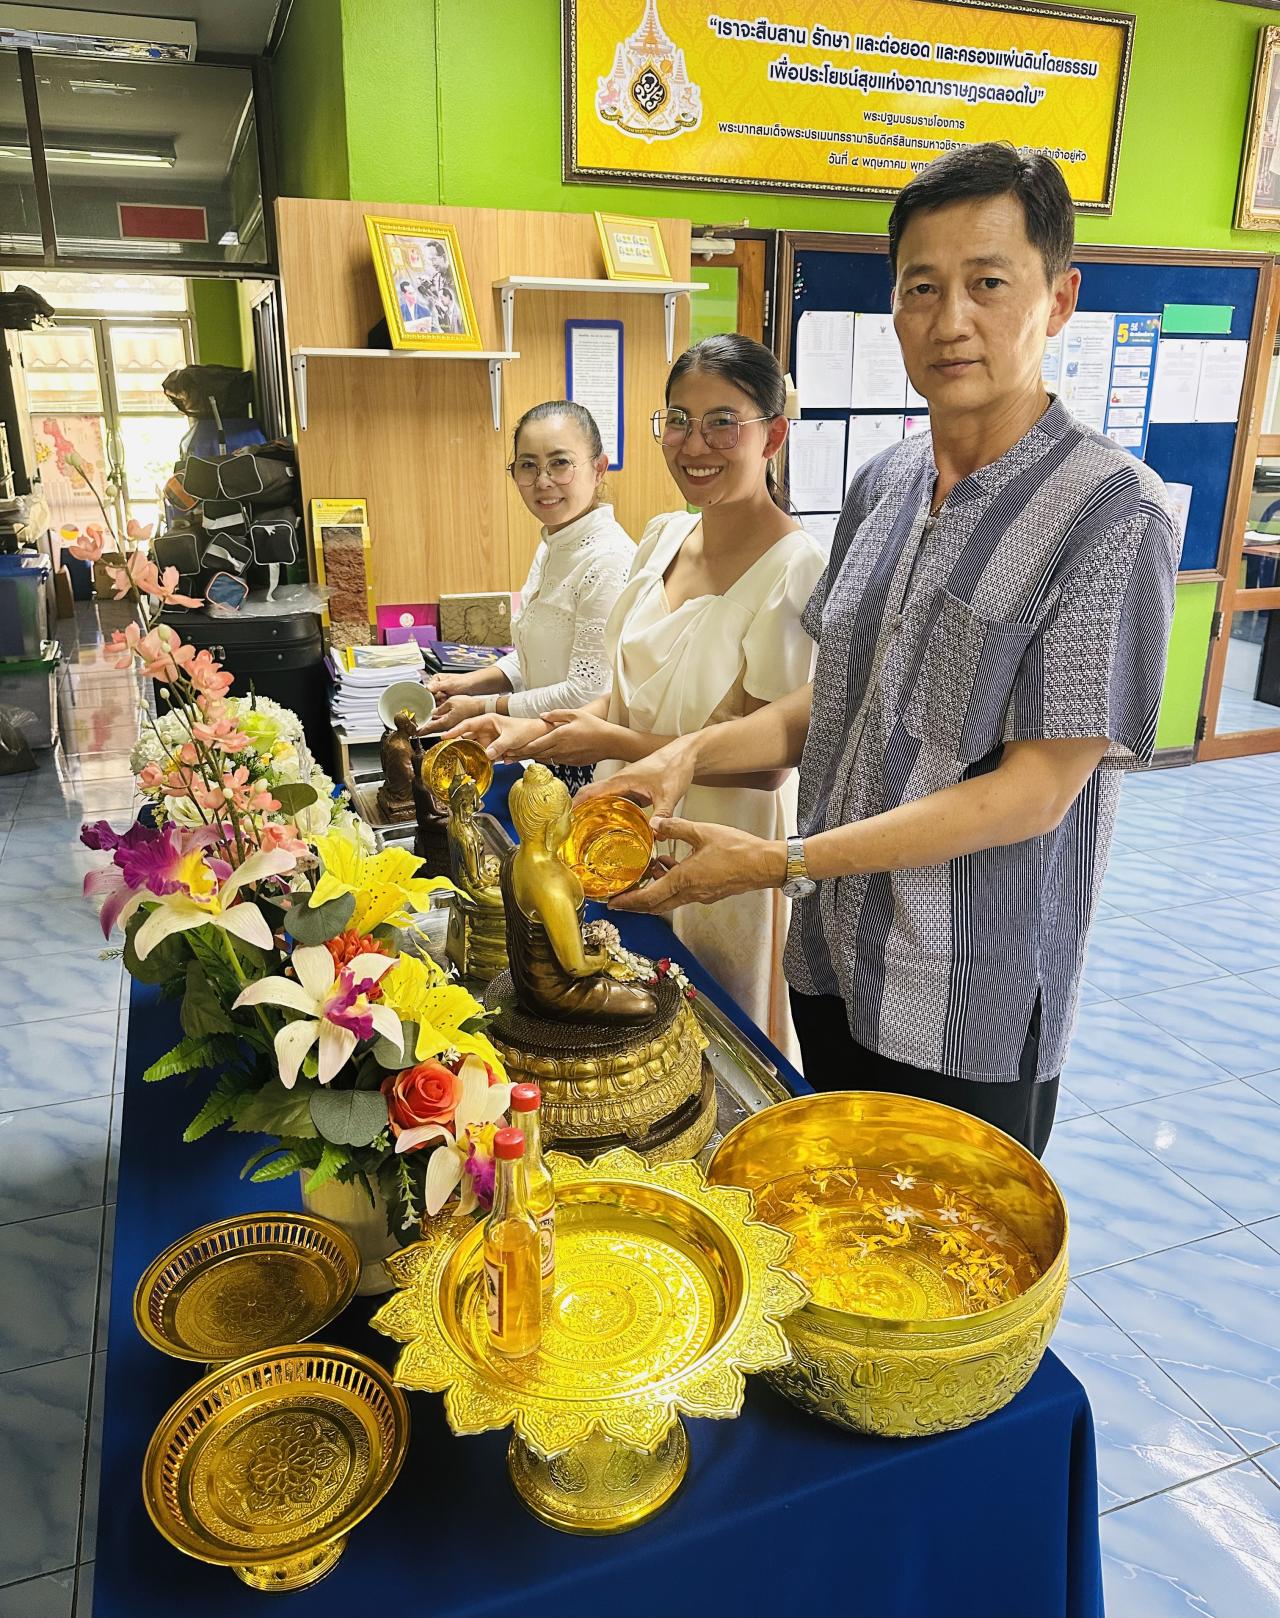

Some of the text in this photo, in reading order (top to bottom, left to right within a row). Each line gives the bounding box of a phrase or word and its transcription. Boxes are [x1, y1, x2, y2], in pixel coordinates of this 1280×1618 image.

[709, 17, 1097, 76] “เราจะสืบสาน รักษา และต่อยอด และครองแผ่นดินโดยธรรม
[863, 111, 965, 129] พระปฐมบรมราชโองการ
[828, 151, 848, 166] วันที่
[862, 157, 907, 170] พฤษภาคม
[1117, 323, 1129, 344] 5
